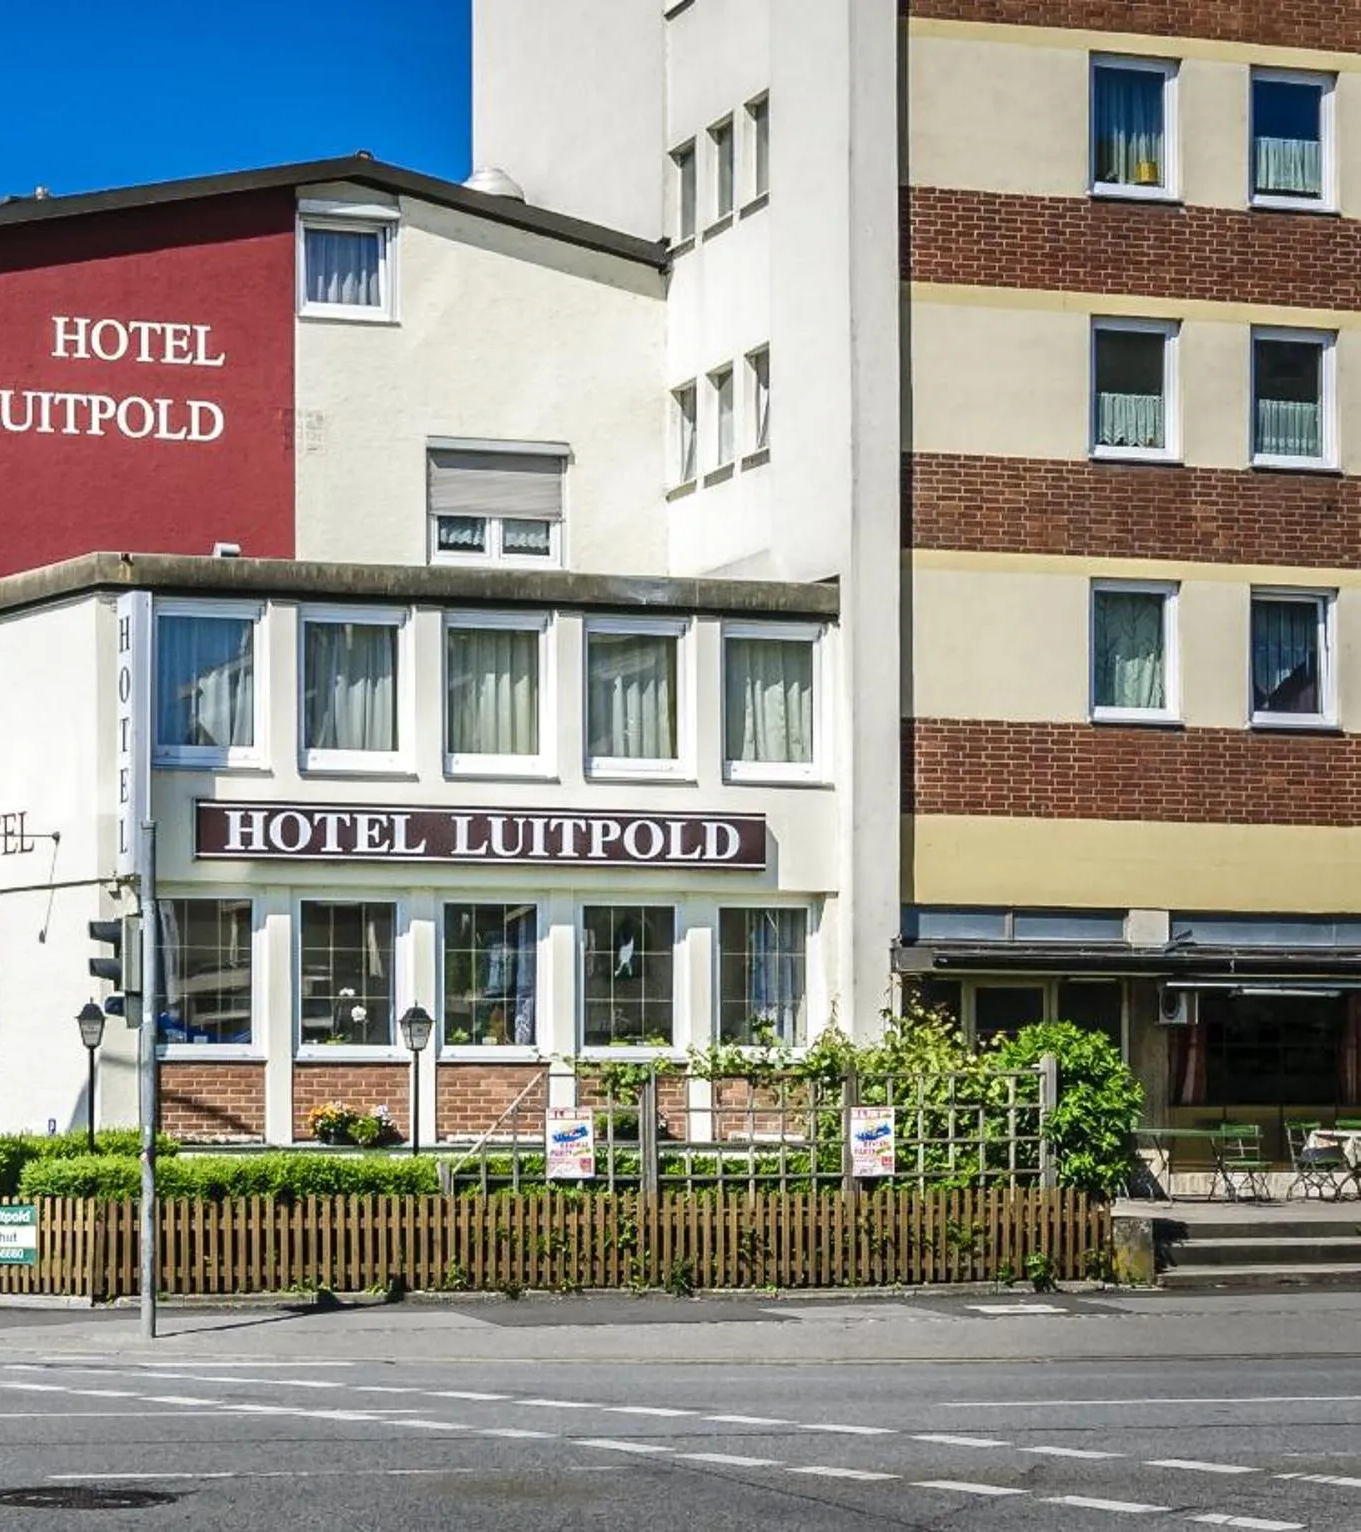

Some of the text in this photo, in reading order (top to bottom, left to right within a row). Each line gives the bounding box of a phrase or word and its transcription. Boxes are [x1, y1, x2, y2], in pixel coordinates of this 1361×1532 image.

[51, 316, 226, 367] HOTEL
[118, 614, 131, 856] HOTEL
[223, 809, 740, 861] HOTEL LUITPOLD
